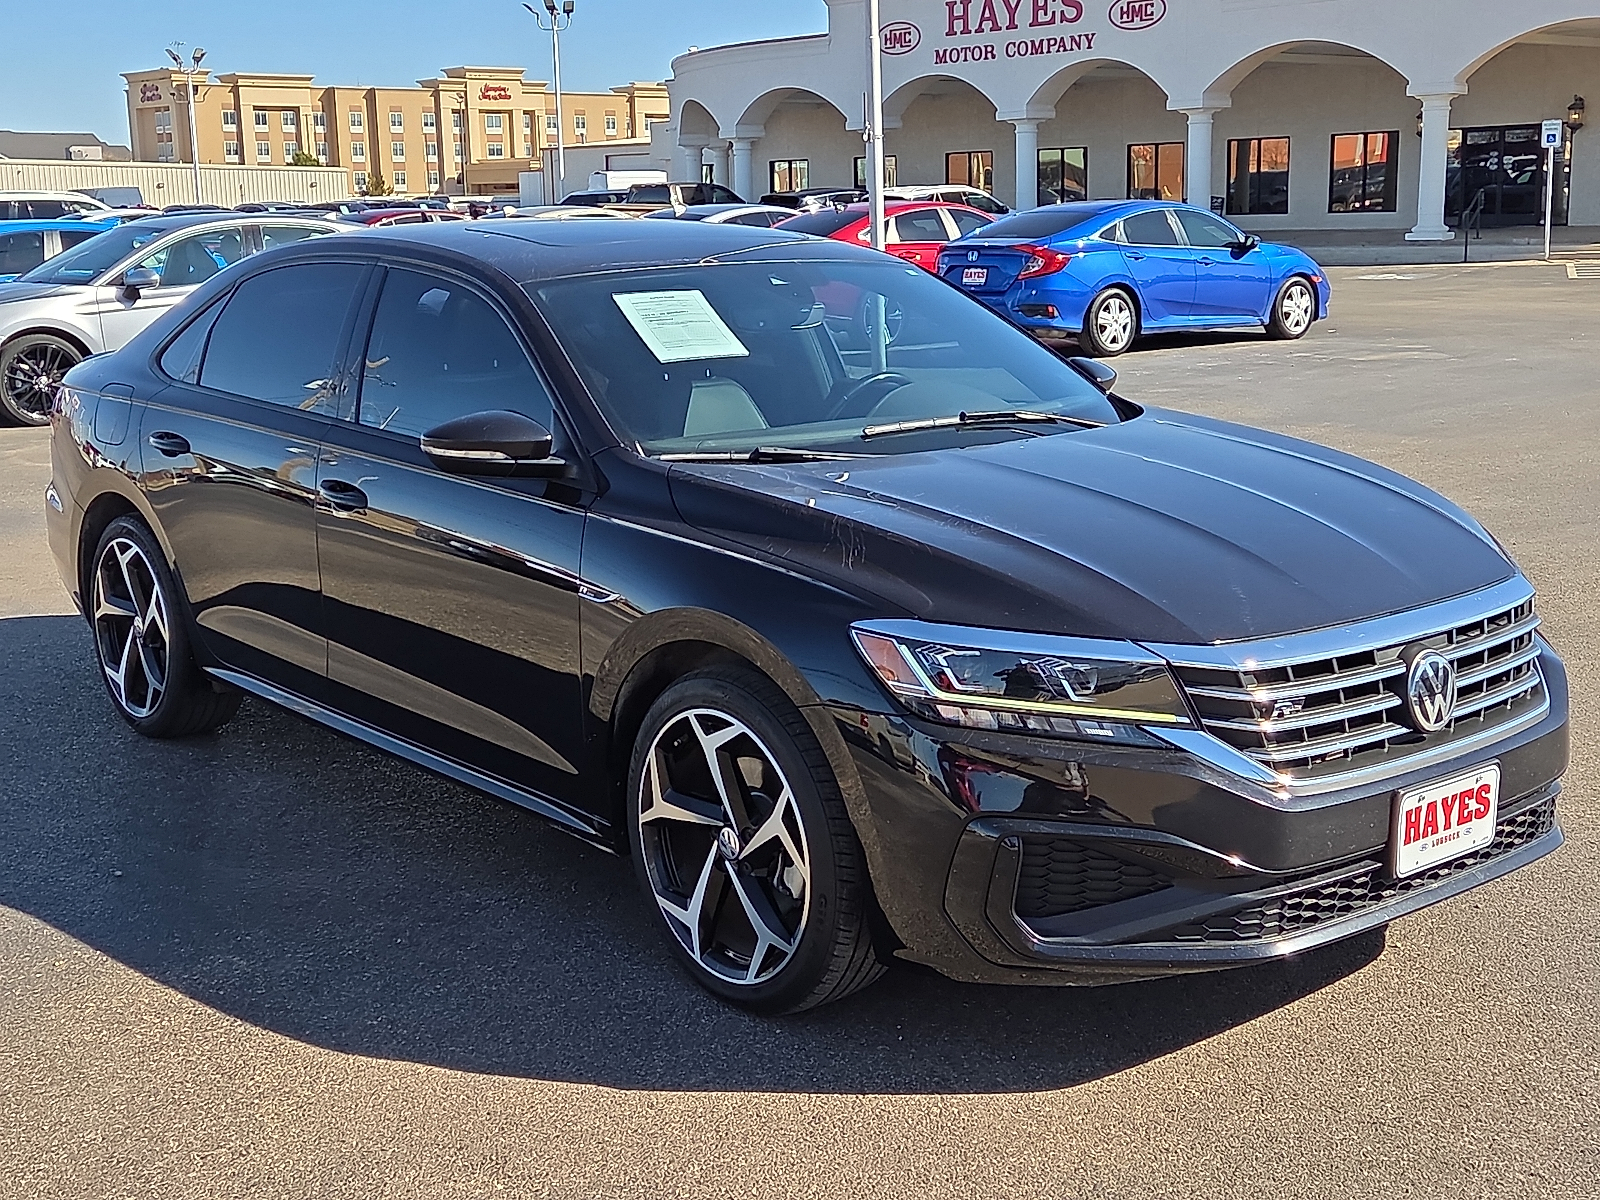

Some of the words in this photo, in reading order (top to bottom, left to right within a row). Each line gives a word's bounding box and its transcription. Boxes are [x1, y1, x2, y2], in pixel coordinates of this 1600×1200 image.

[945, 0, 1083, 36] HAYES
[1120, 1, 1154, 23] HMC
[884, 27, 912, 48] HMC
[933, 44, 997, 65] MOTOR
[1006, 32, 1096, 58] COMPANY
[1403, 783, 1491, 847] HAYES
